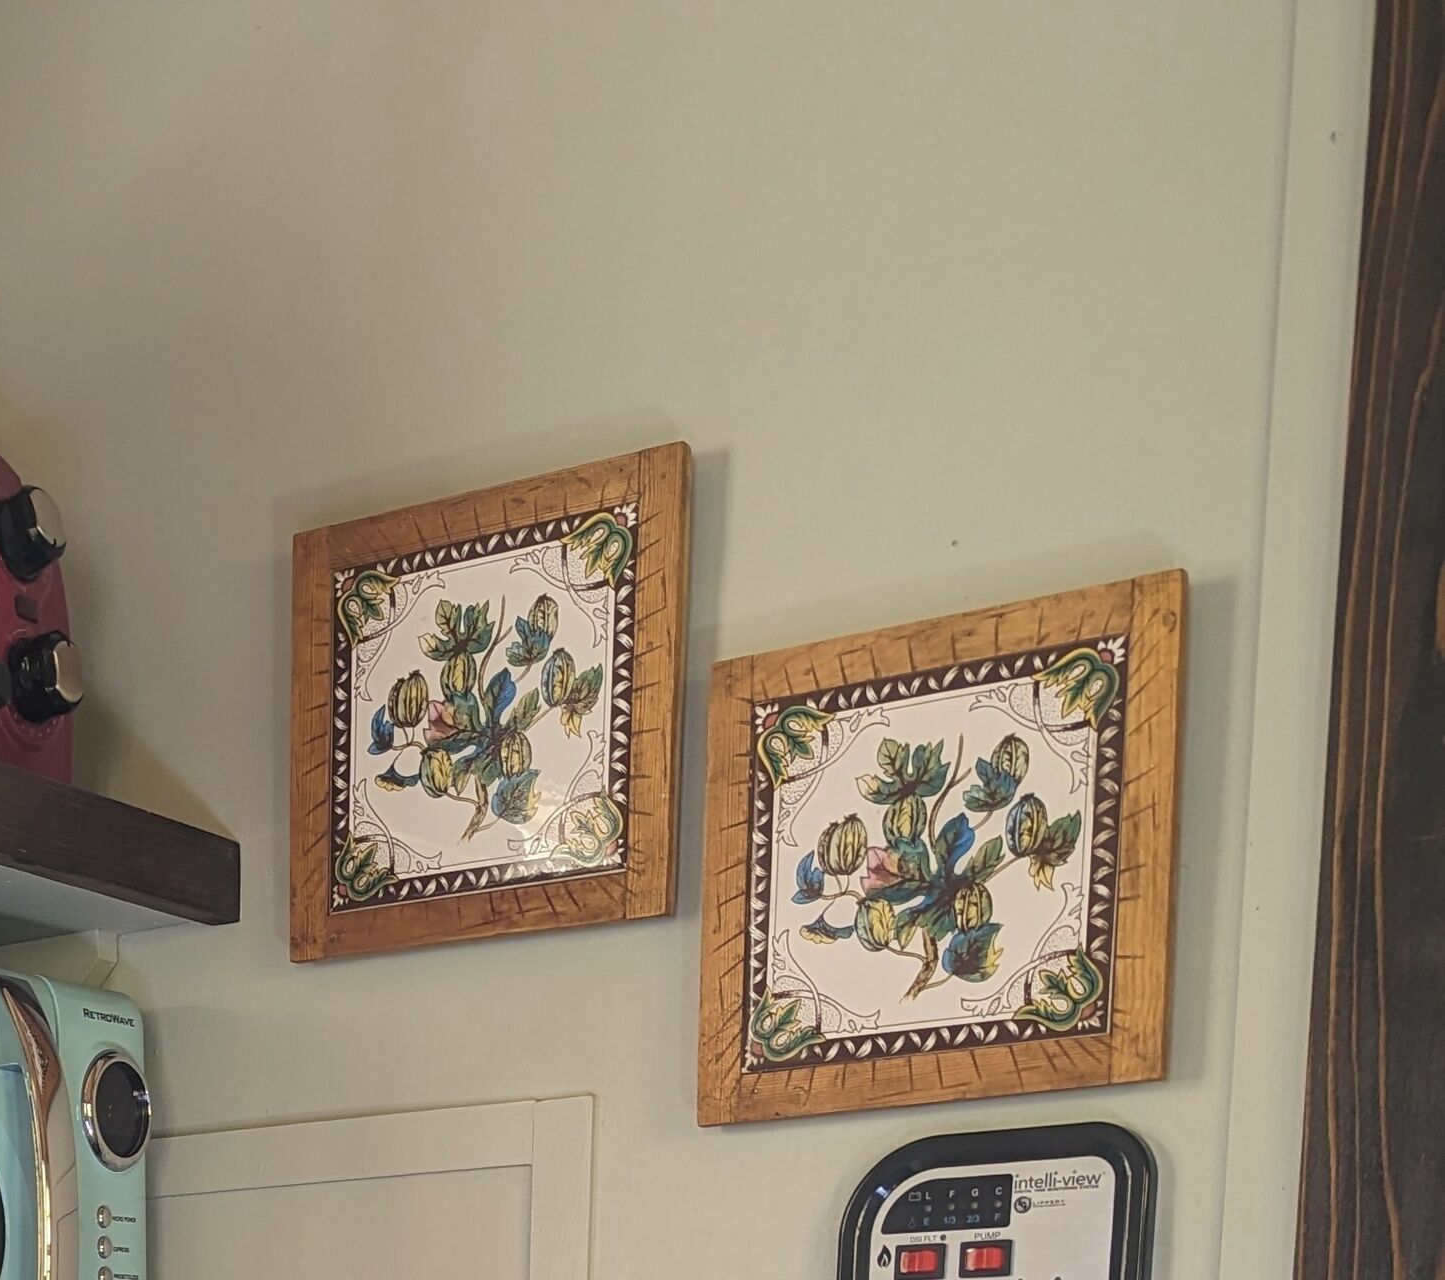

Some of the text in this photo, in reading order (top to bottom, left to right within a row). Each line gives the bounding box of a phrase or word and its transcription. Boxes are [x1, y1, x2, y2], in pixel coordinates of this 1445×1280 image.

[1014, 1170, 1102, 1190] intelli-view
[971, 1188, 979, 1197] G
[995, 1186, 1003, 1195] C
[966, 1215, 980, 1223] 2/3
[974, 1232, 1001, 1240] PUMP
